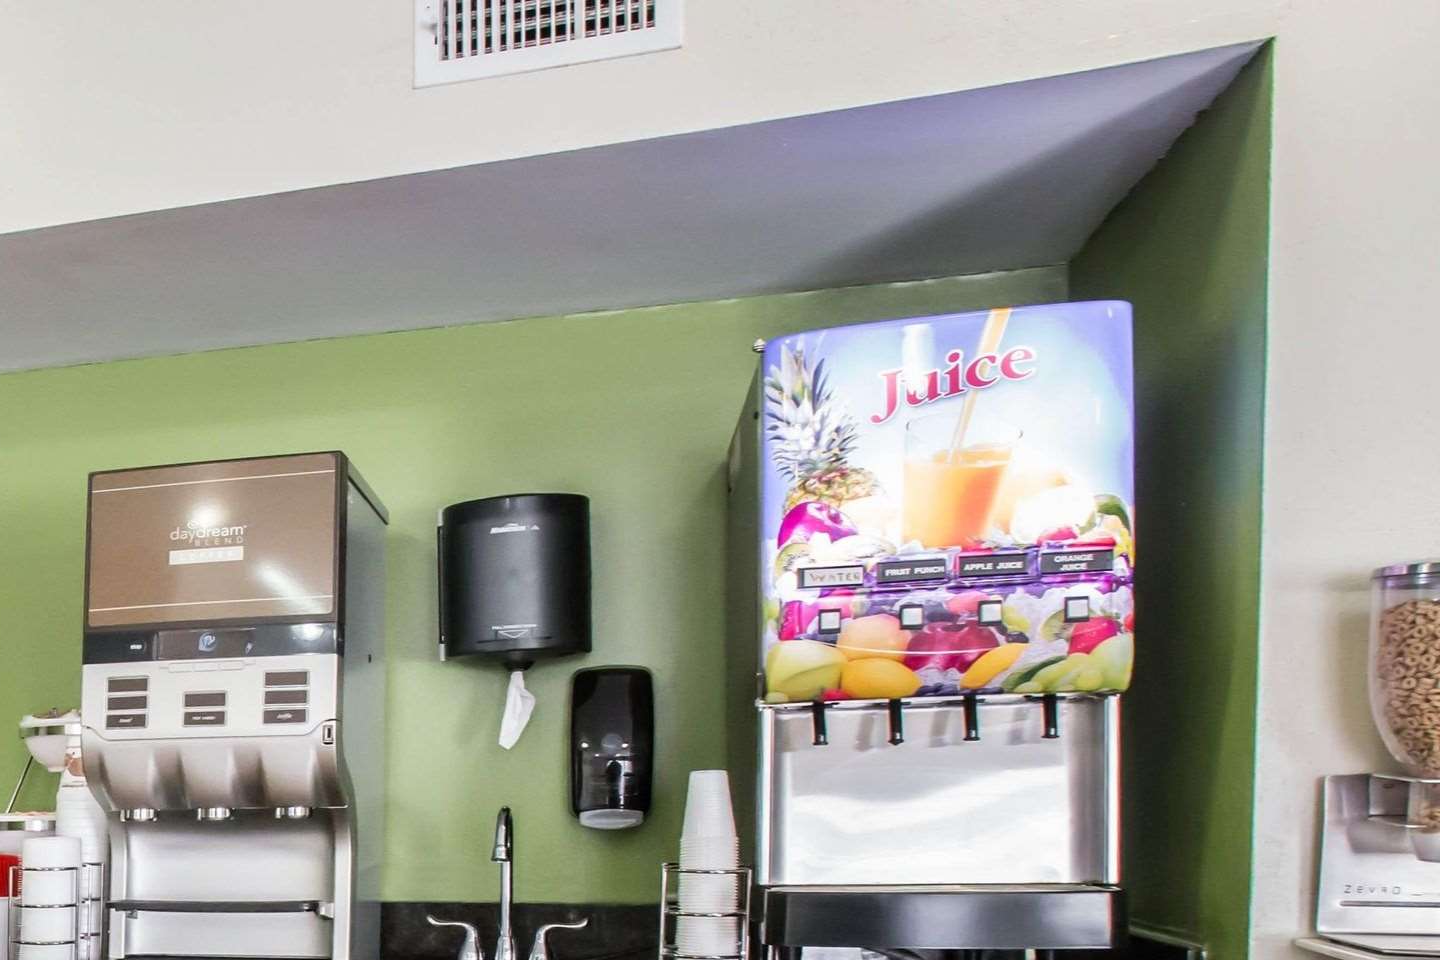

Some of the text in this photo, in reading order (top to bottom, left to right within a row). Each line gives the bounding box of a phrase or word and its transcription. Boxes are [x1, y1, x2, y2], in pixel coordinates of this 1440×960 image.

[870, 347, 1036, 424] Juice
[169, 525, 245, 544] daydream
[1053, 554, 1094, 563] ORANGE
[963, 561, 1024, 571] APPLE JUICE
[1060, 563, 1088, 571] JUICE
[885, 566, 945, 577] FRUIT PUNCH
